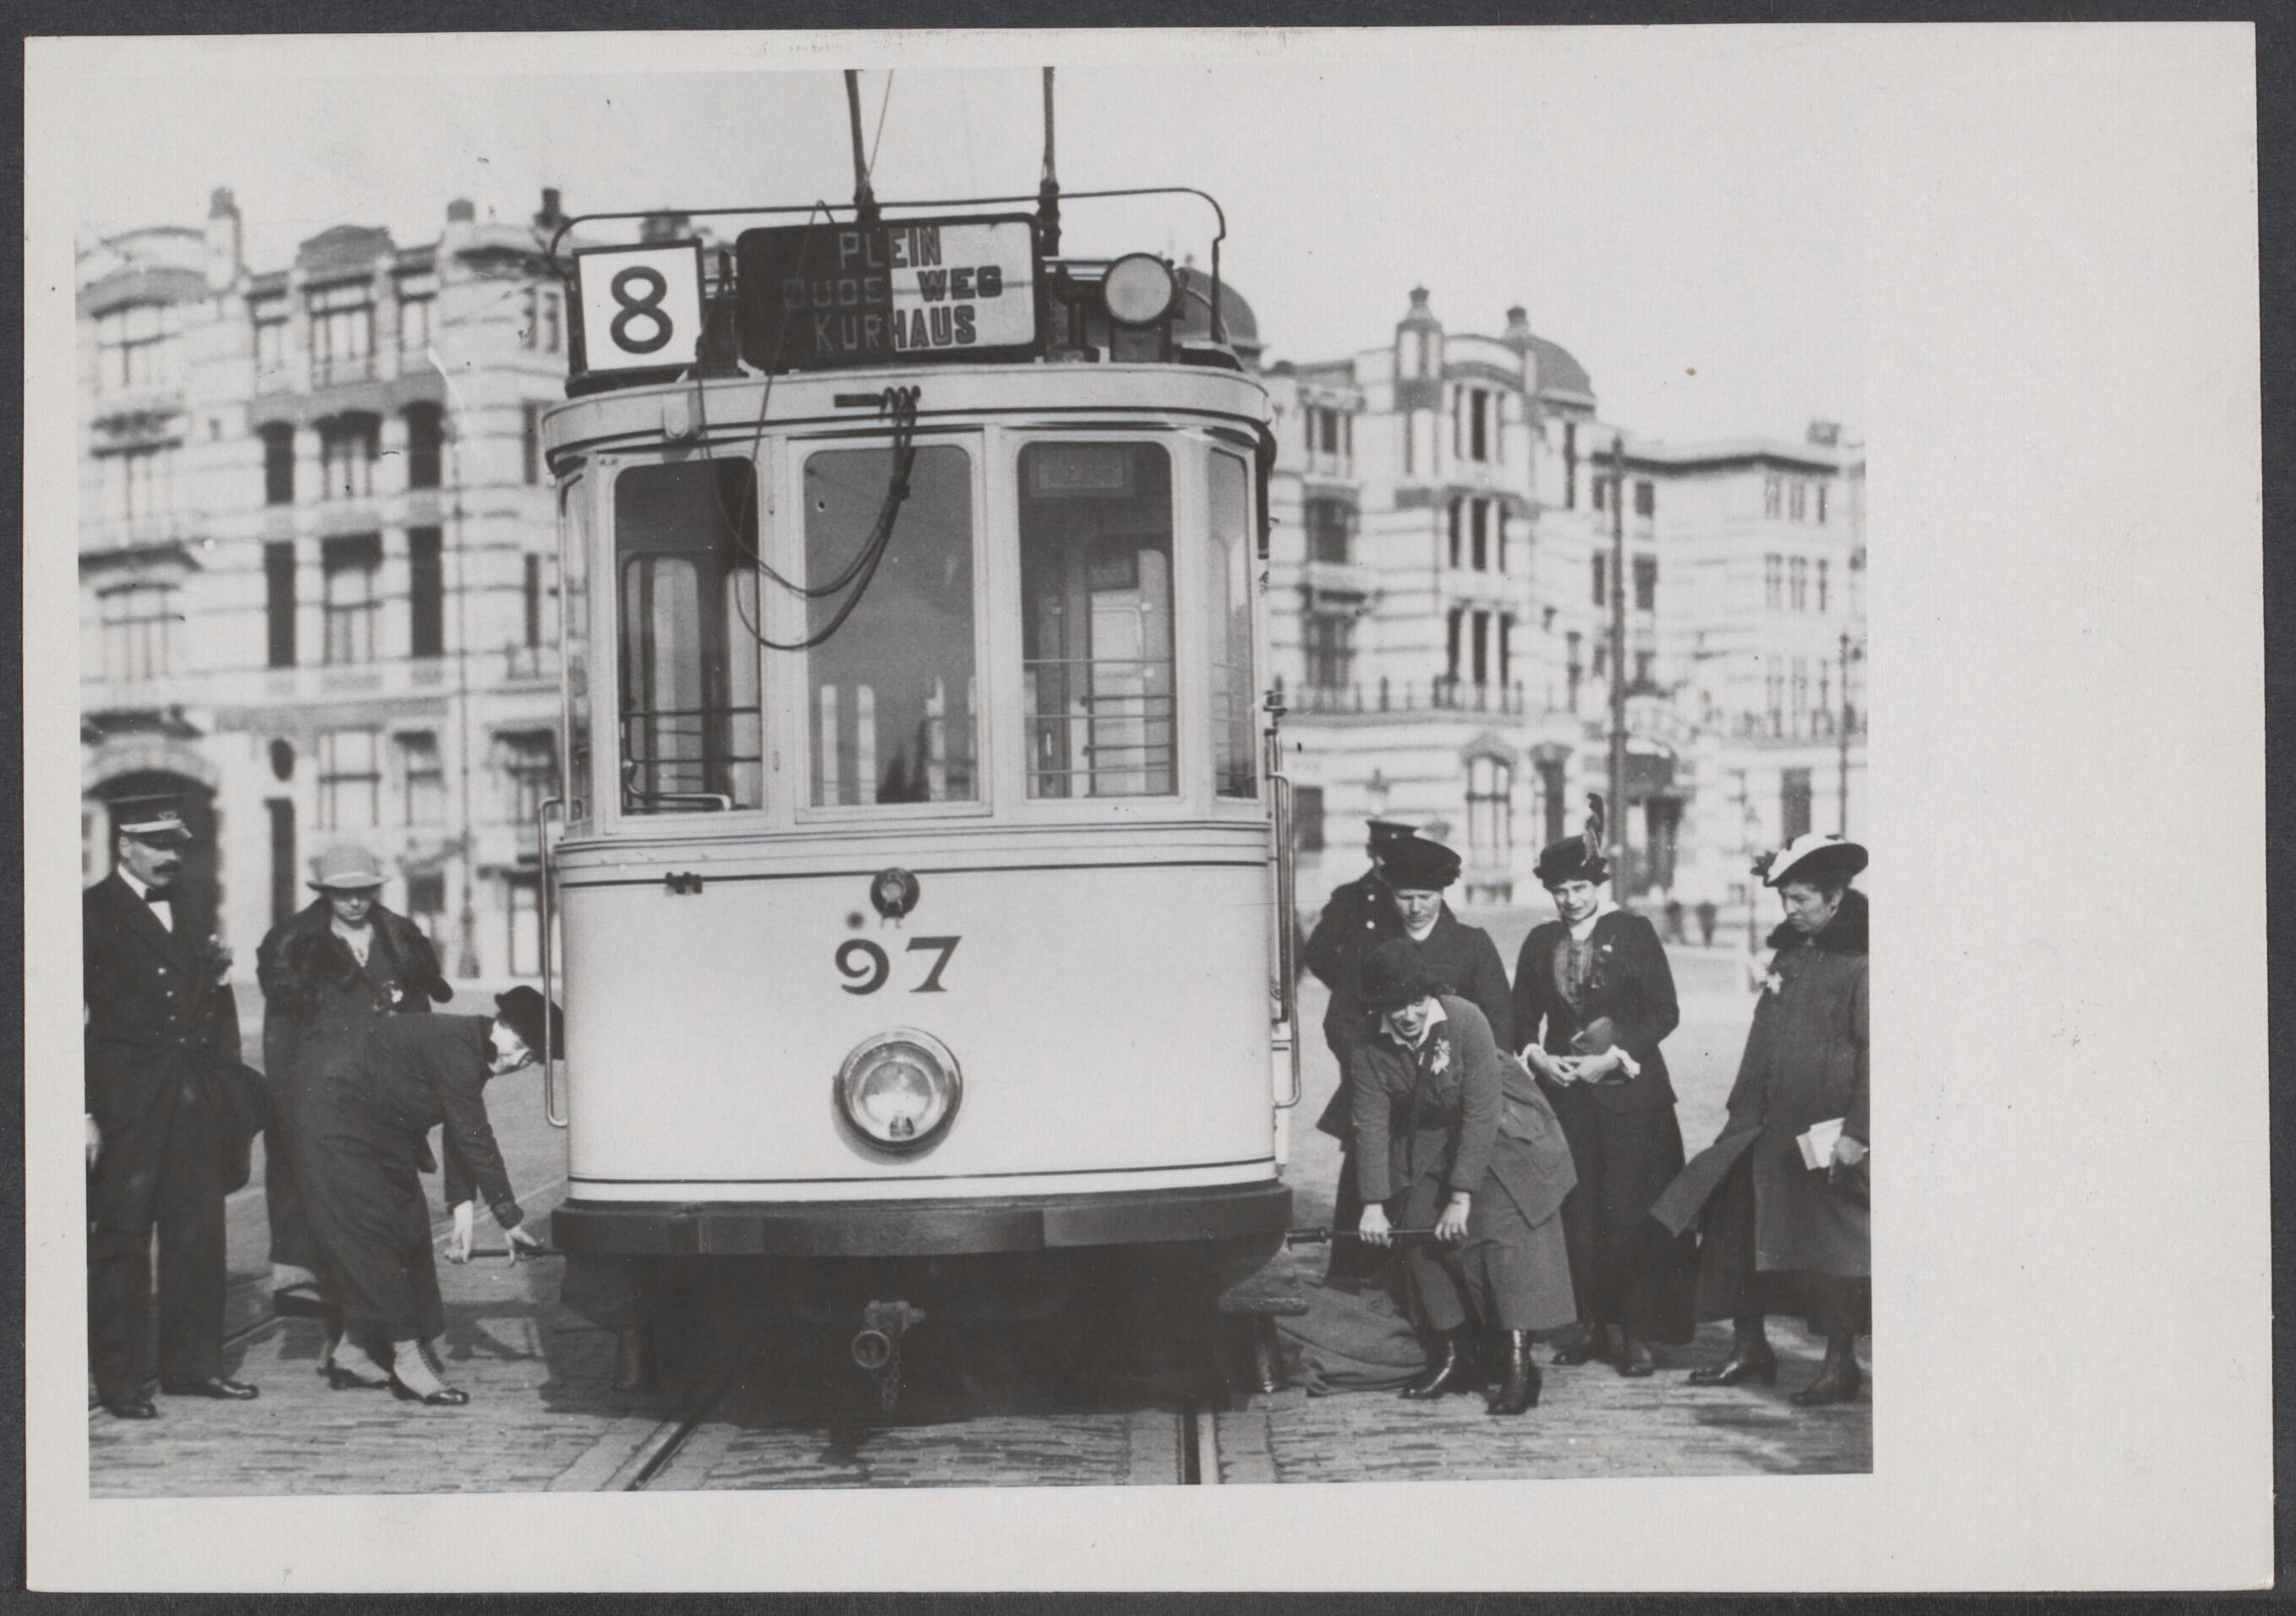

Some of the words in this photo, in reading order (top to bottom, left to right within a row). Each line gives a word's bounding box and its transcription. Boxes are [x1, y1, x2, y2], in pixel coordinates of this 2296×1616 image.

[839, 227, 942, 270] PLEIN
[610, 266, 674, 355] 8
[782, 276, 885, 310] OUDE
[917, 265, 1003, 303] WEG
[814, 304, 977, 353] KURHAUS
[835, 935, 962, 995] 97
